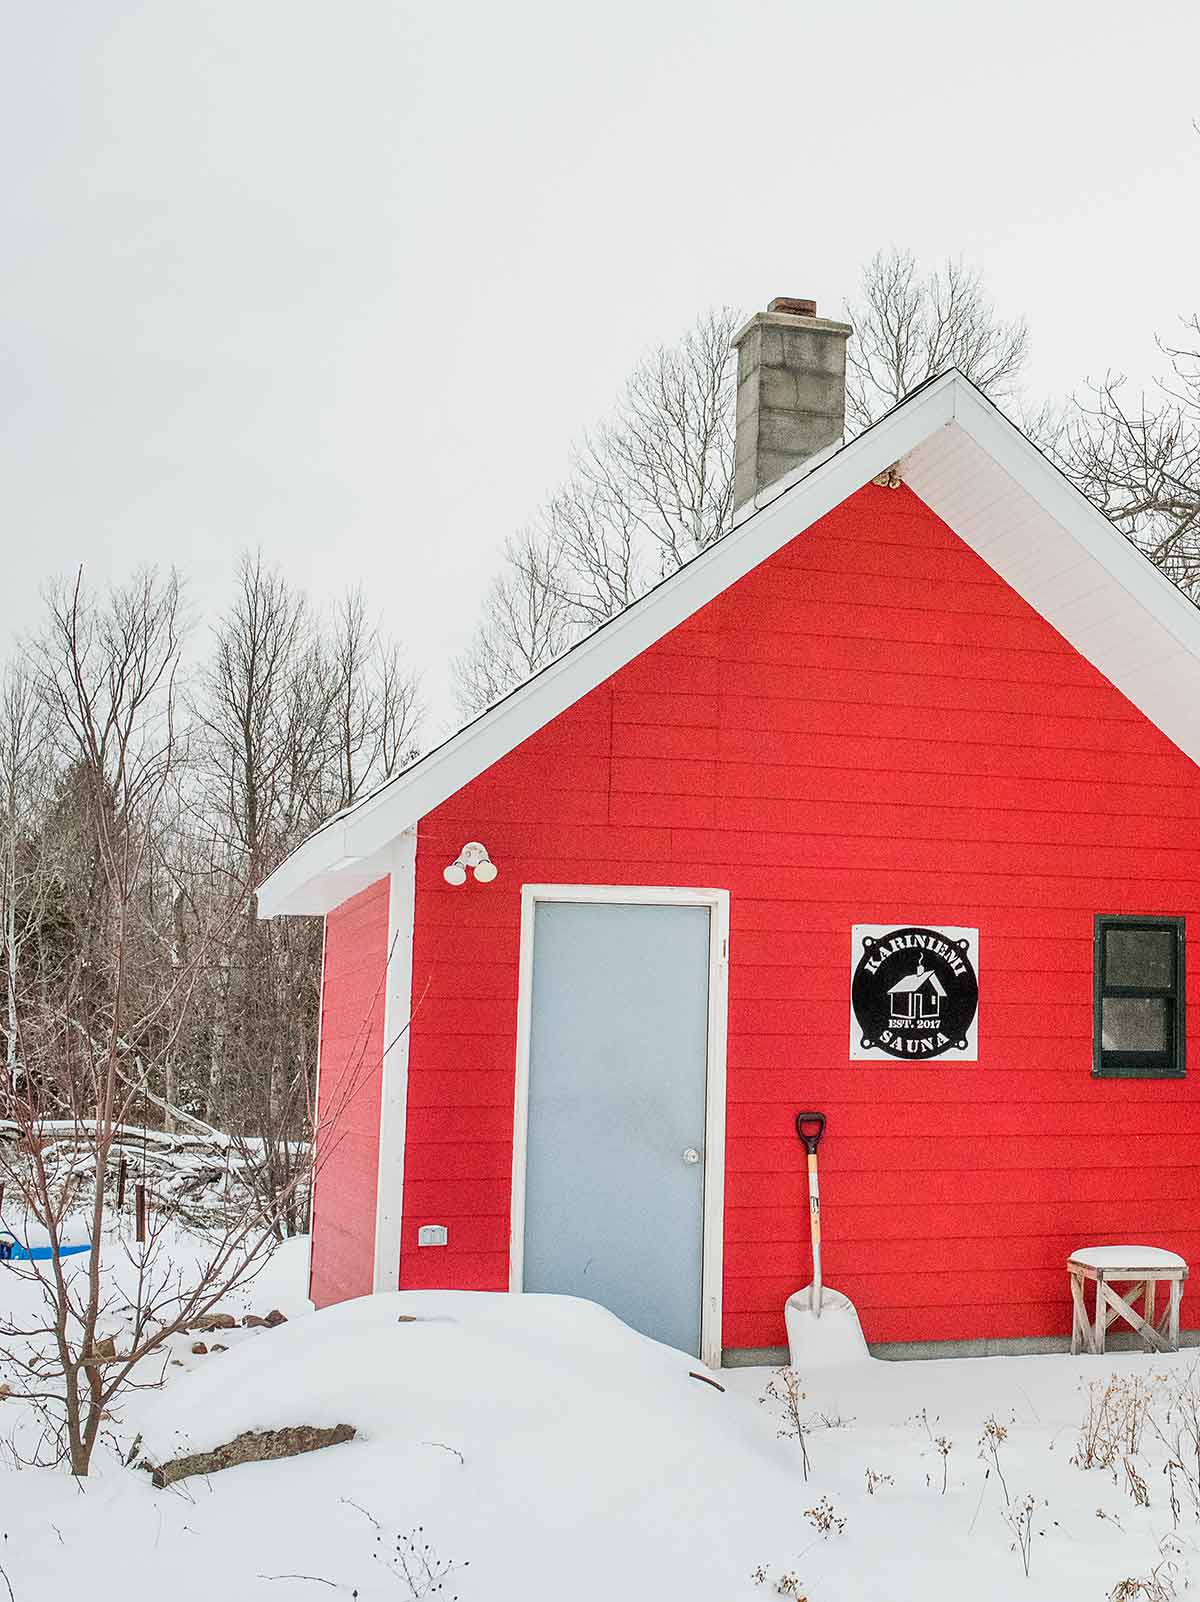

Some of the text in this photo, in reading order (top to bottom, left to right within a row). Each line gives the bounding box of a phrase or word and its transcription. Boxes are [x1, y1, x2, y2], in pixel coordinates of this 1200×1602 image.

[864, 934, 967, 977] KARINIEMI
[888, 1019, 942, 1029] EST. 2017
[879, 1030, 951, 1053] SAUNA
